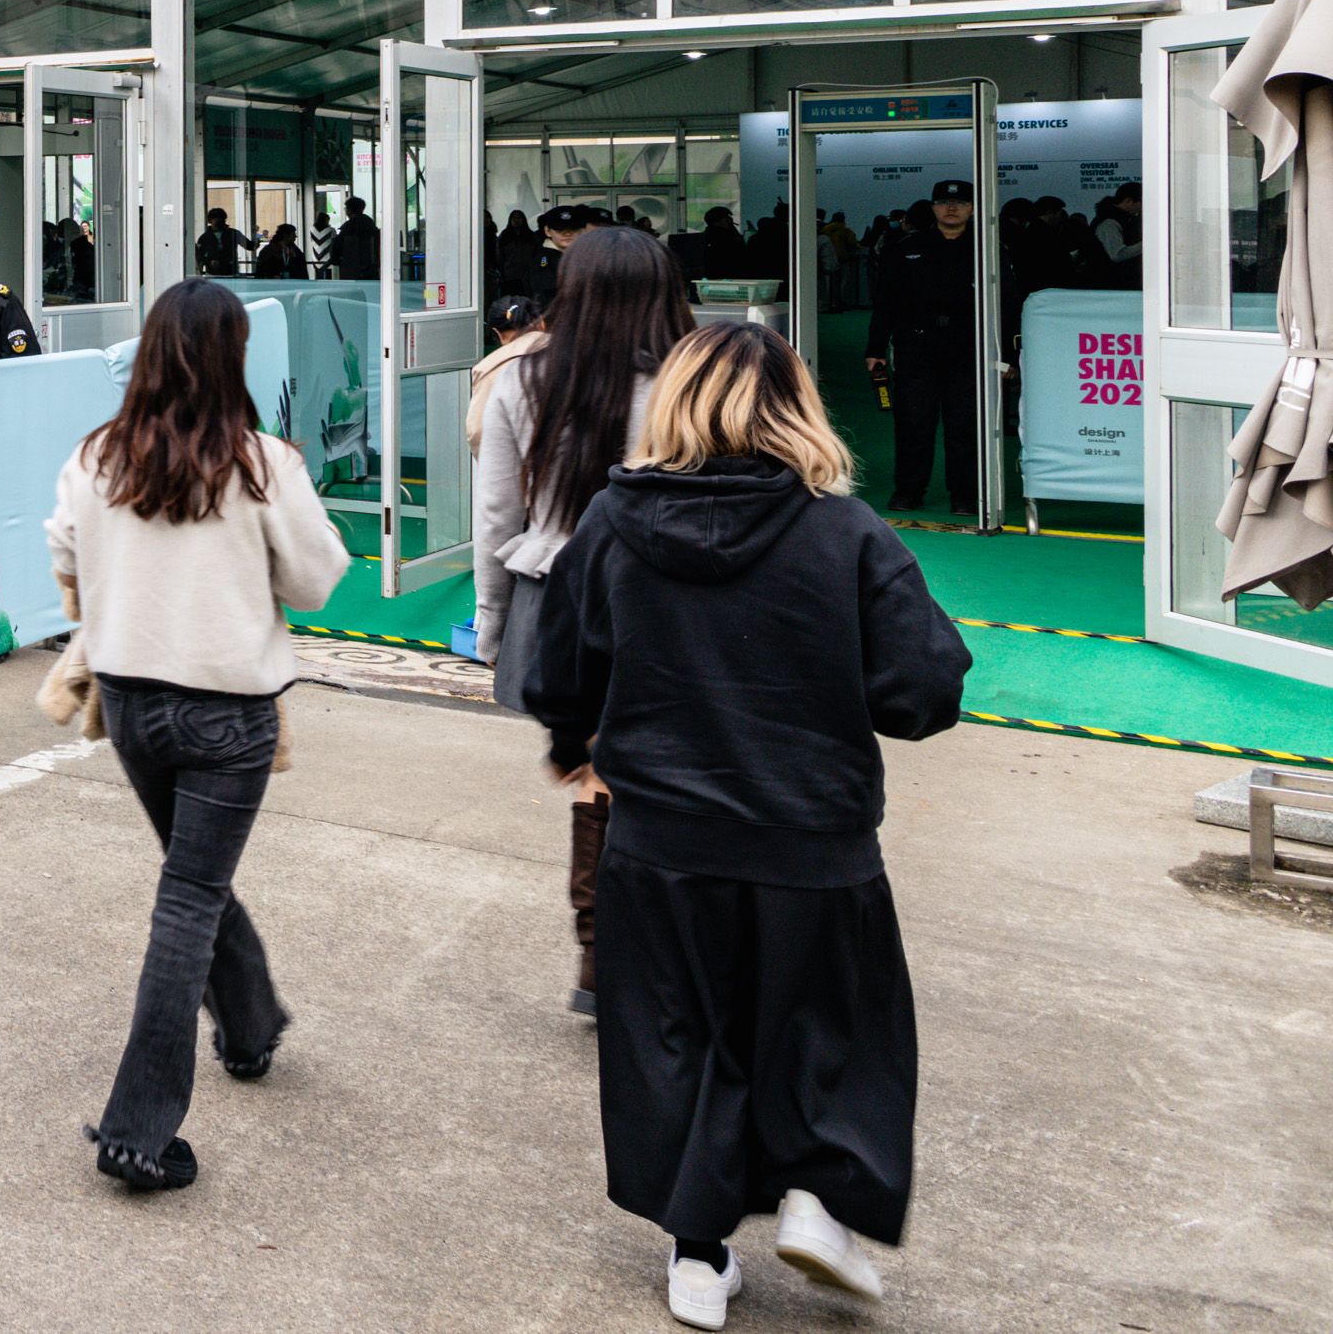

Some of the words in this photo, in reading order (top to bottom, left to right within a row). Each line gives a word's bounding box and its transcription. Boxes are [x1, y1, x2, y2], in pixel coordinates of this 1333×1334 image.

[1018, 119, 1068, 129] SERVICES
[1078, 333, 1143, 356] DESI
[1079, 382, 1142, 406] 202
[1078, 426, 1126, 439] design
[1084, 448, 1121, 457] 设计上海
